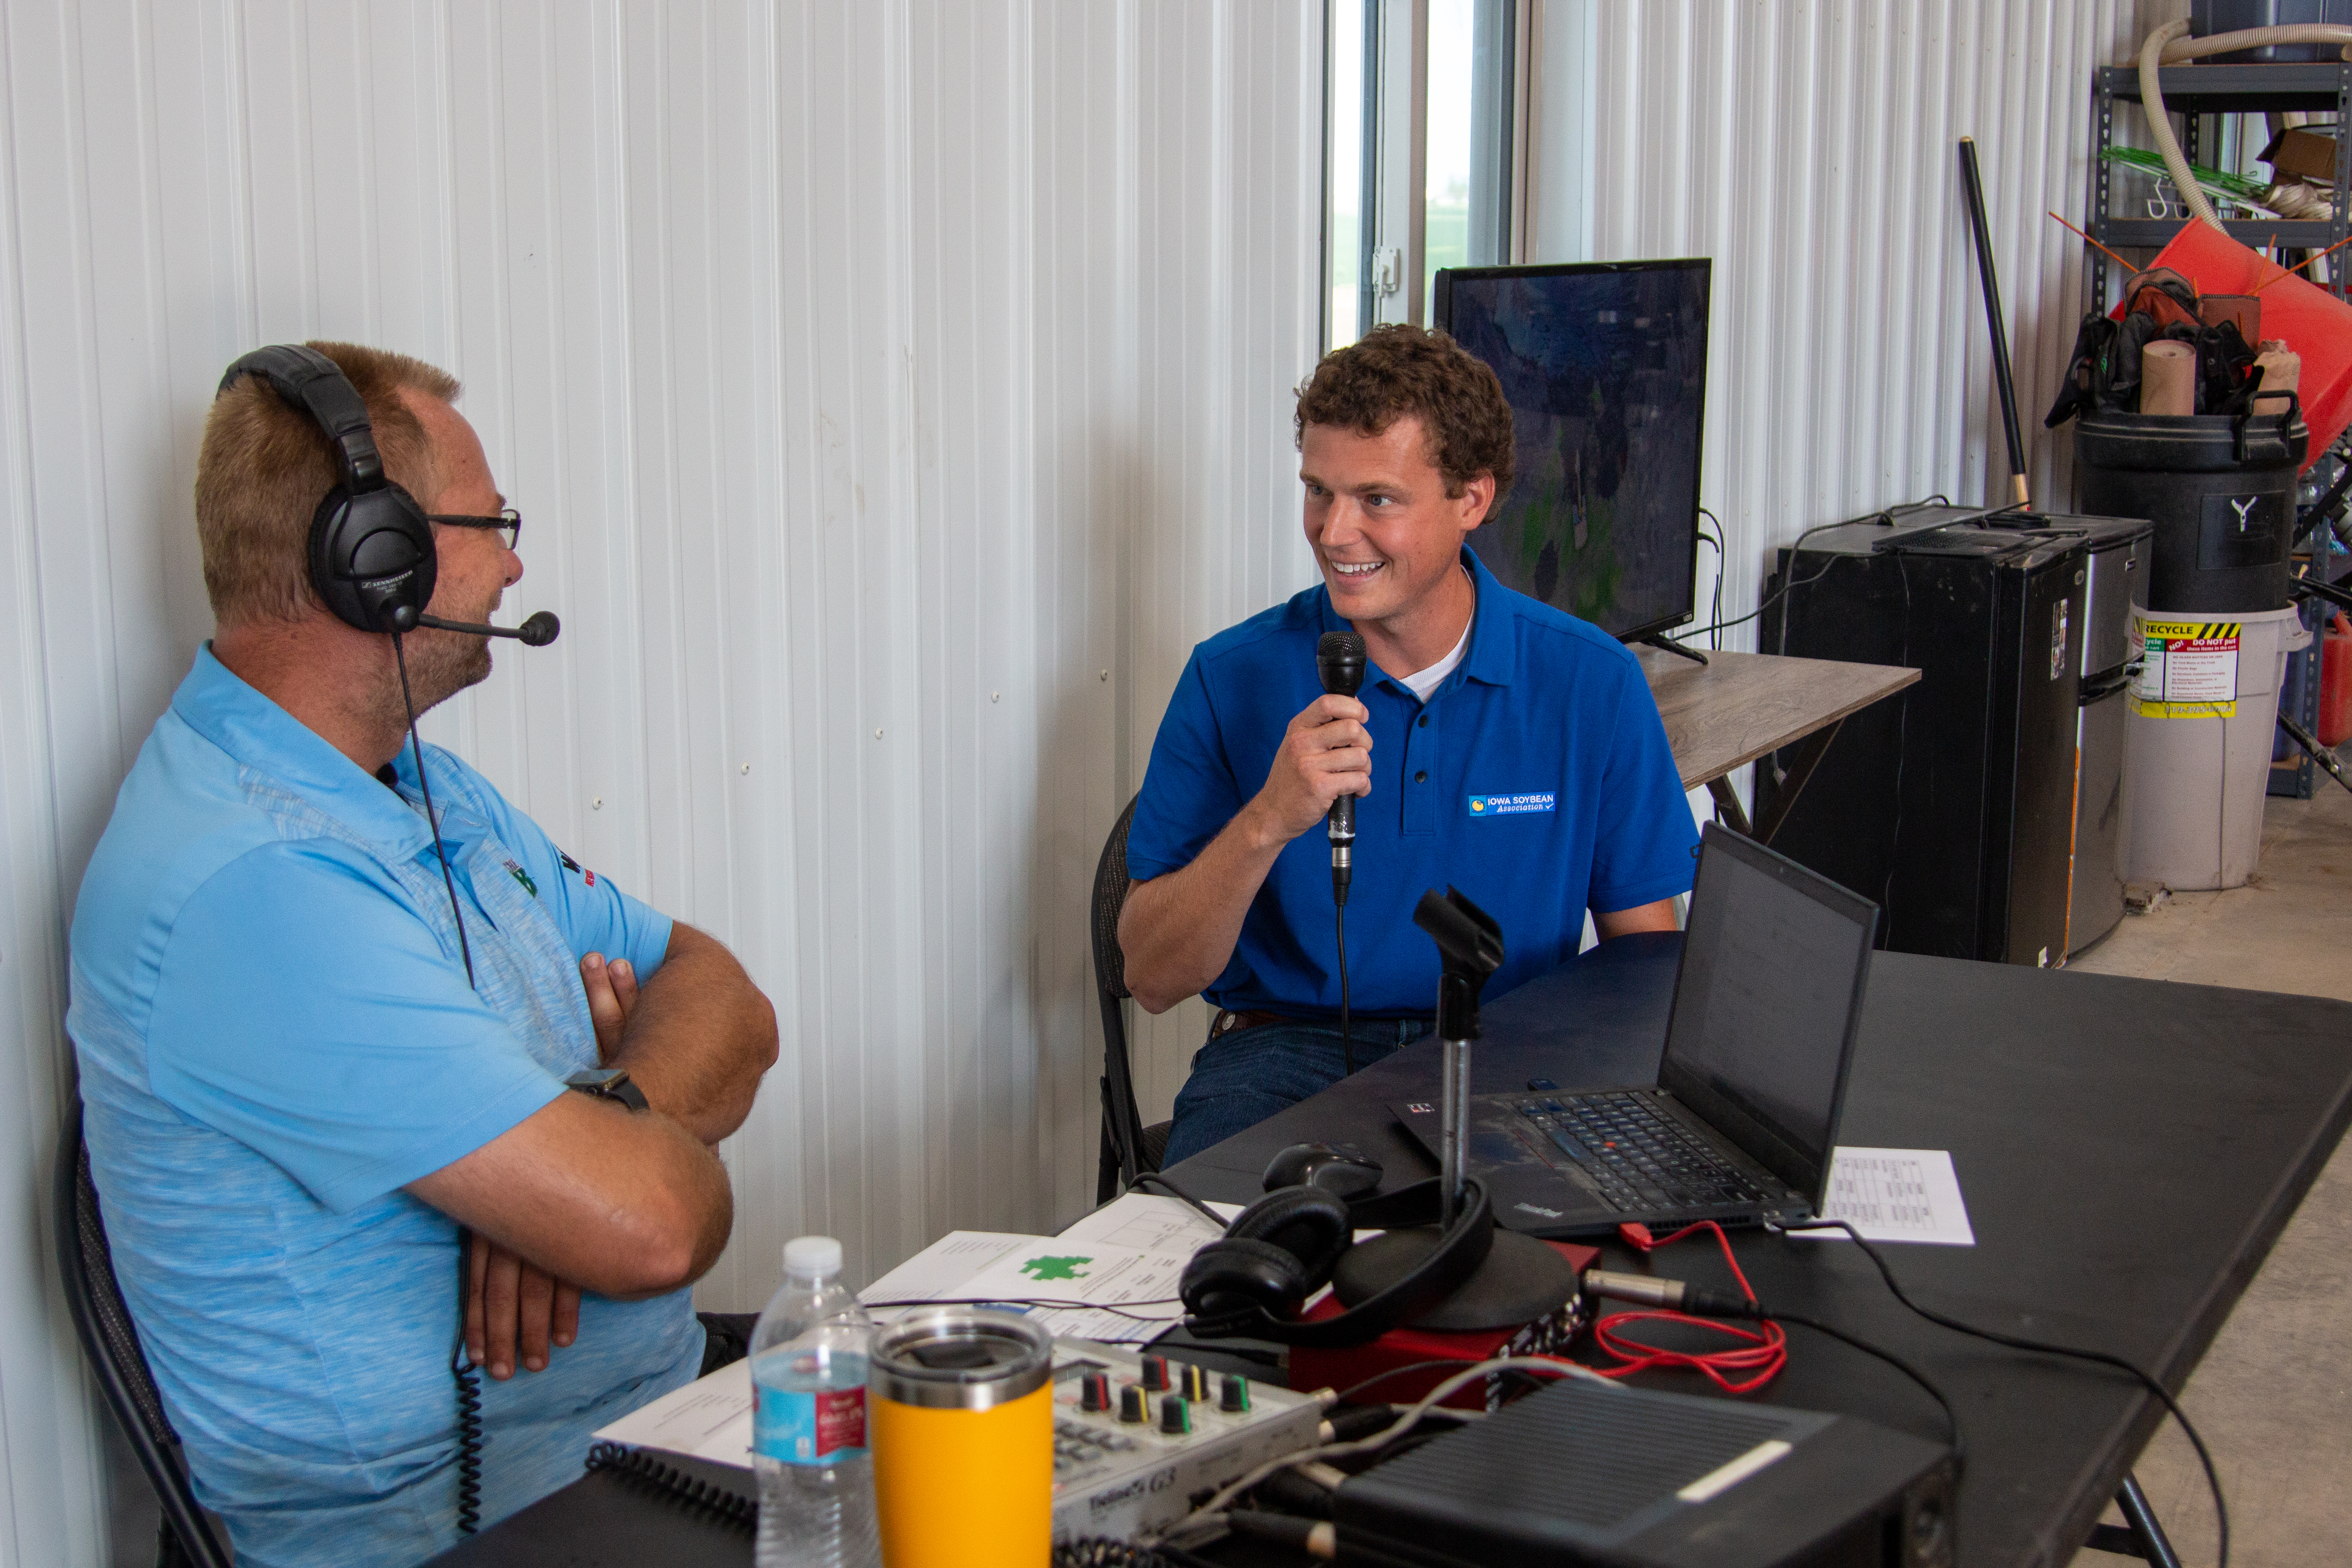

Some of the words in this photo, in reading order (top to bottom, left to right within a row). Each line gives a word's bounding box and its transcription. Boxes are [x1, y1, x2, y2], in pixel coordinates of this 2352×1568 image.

[372, 570, 413, 587] SENNHEISER
[1488, 797, 1511, 806] IOWA
[1513, 795, 1553, 804] SOYBEAN
[1497, 804, 1543, 812] Association
